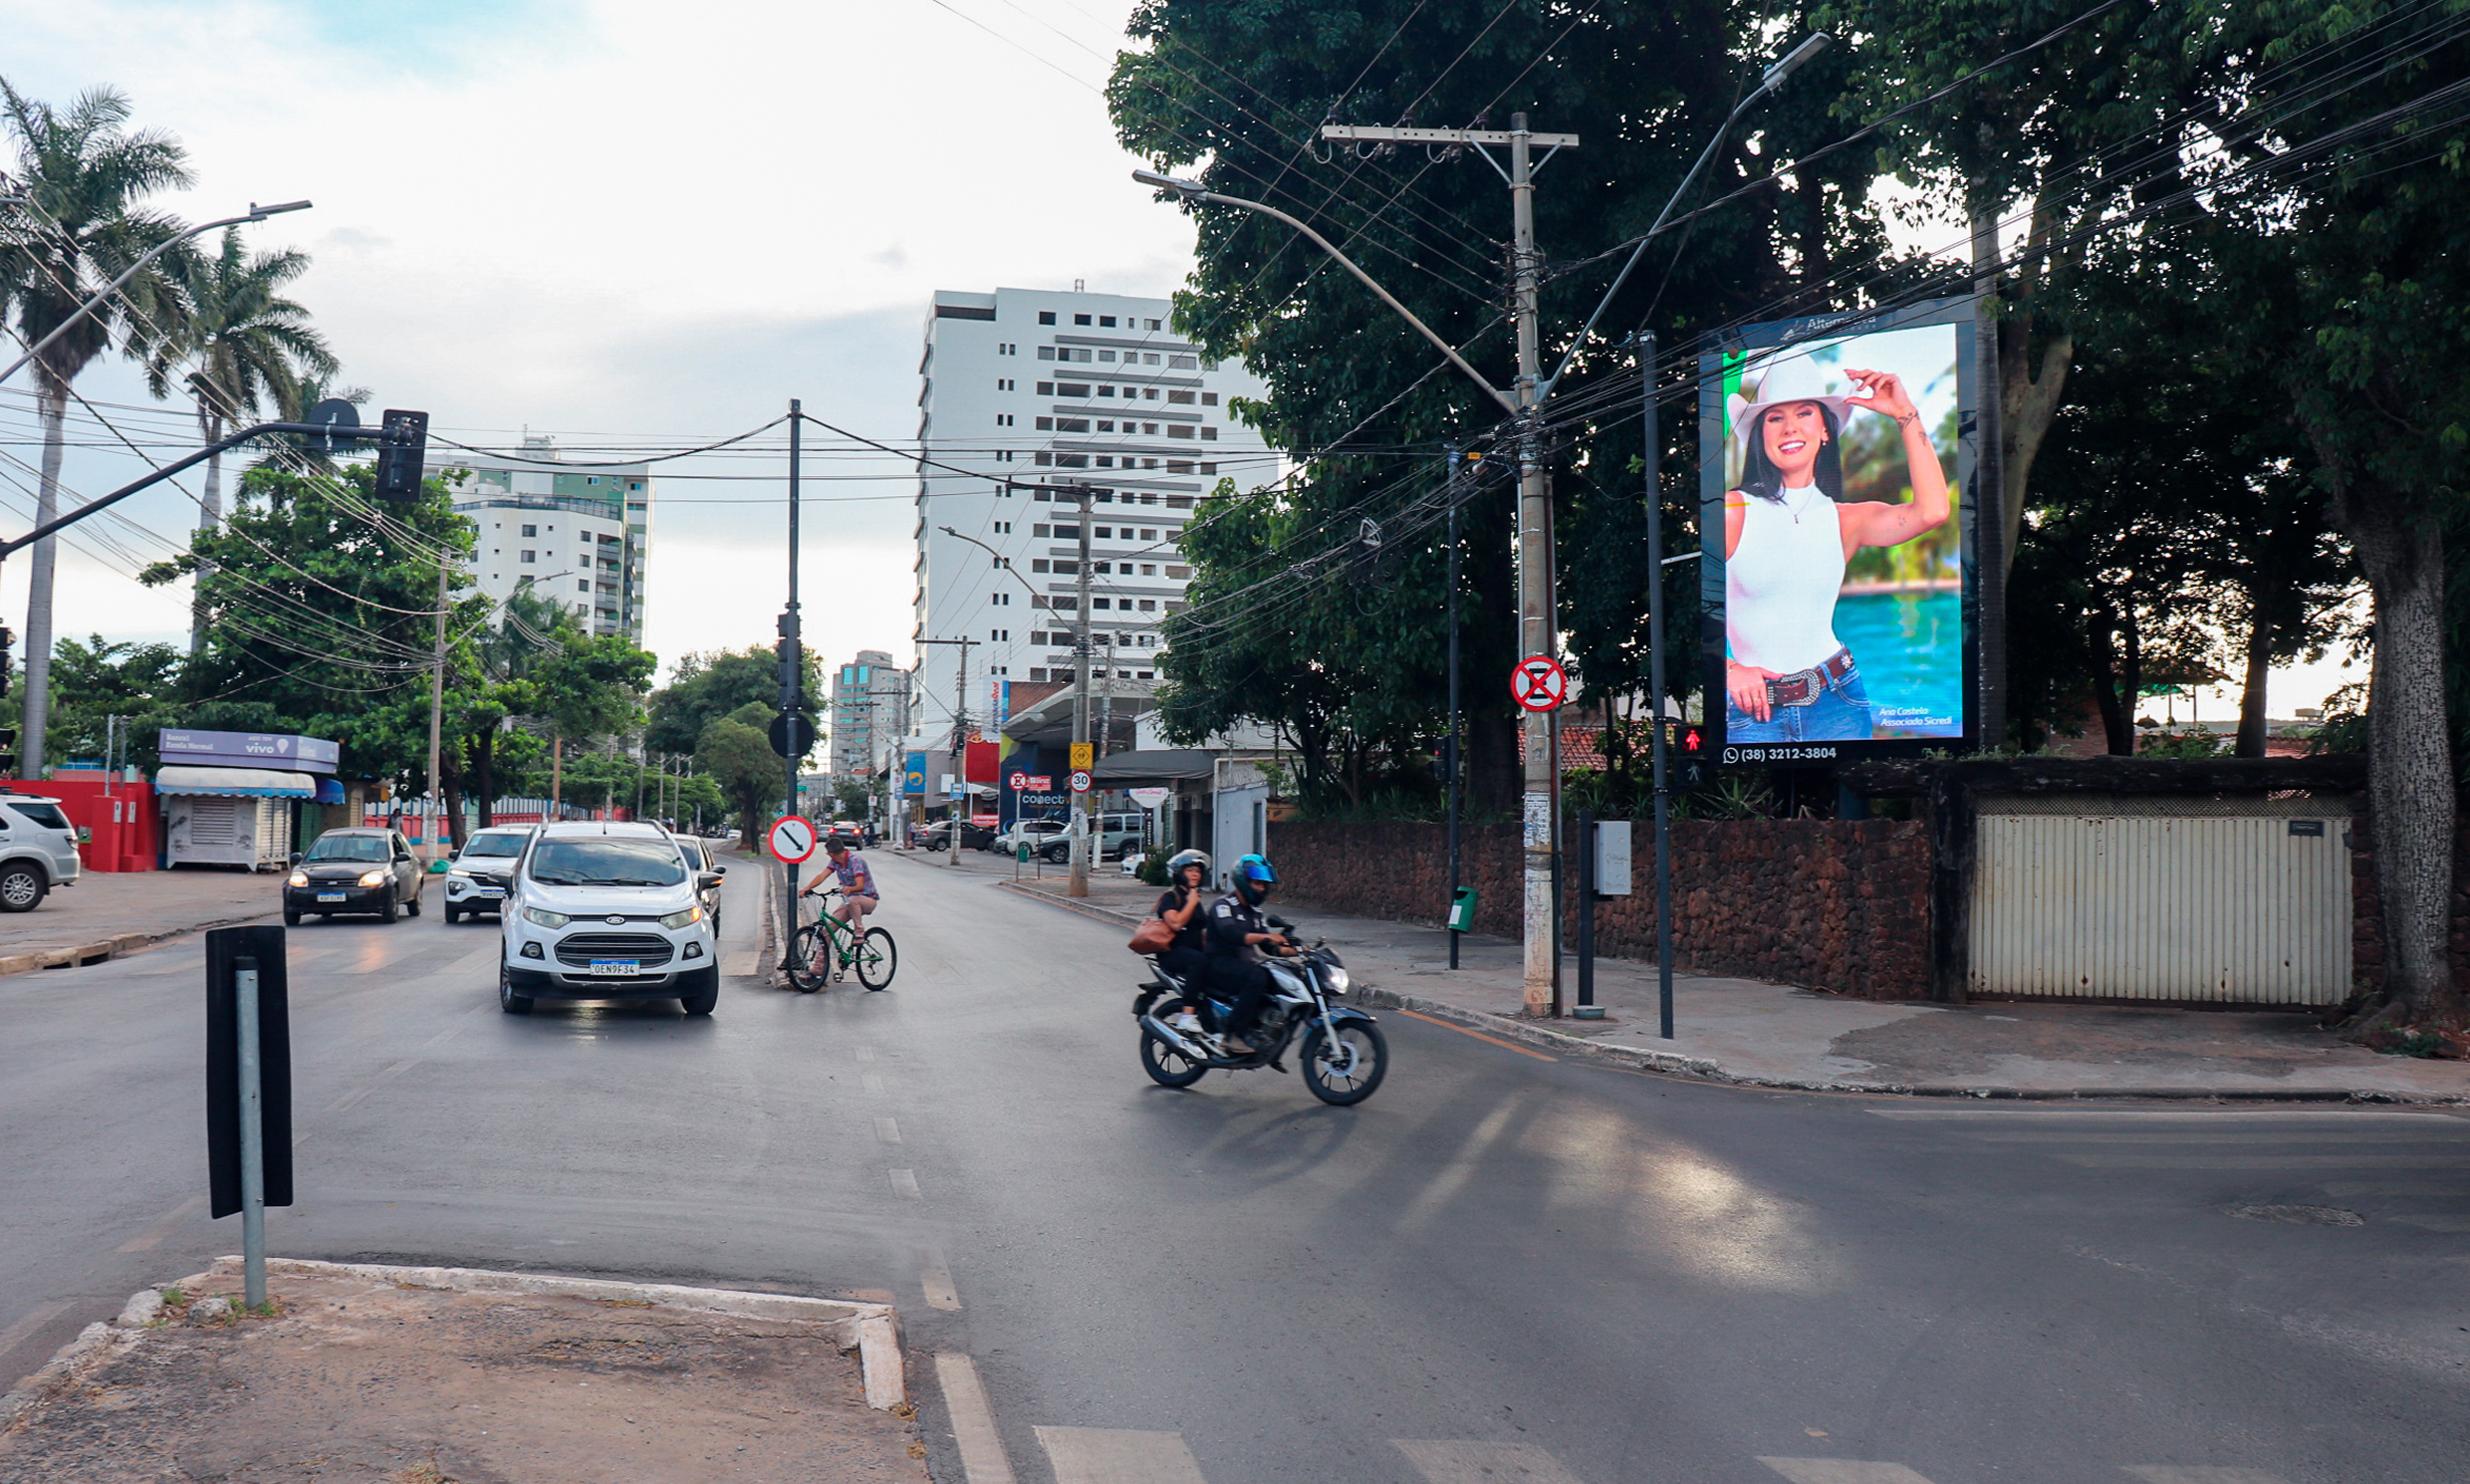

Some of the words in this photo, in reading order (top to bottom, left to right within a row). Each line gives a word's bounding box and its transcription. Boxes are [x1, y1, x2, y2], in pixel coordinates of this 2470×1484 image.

[1924, 716, 1952, 725] Sicredi
[245, 742, 275, 754] vivo
[1742, 749, 1765, 762] (38)
[1769, 747, 1837, 759] 3212-3804
[1074, 775, 1089, 786] 30
